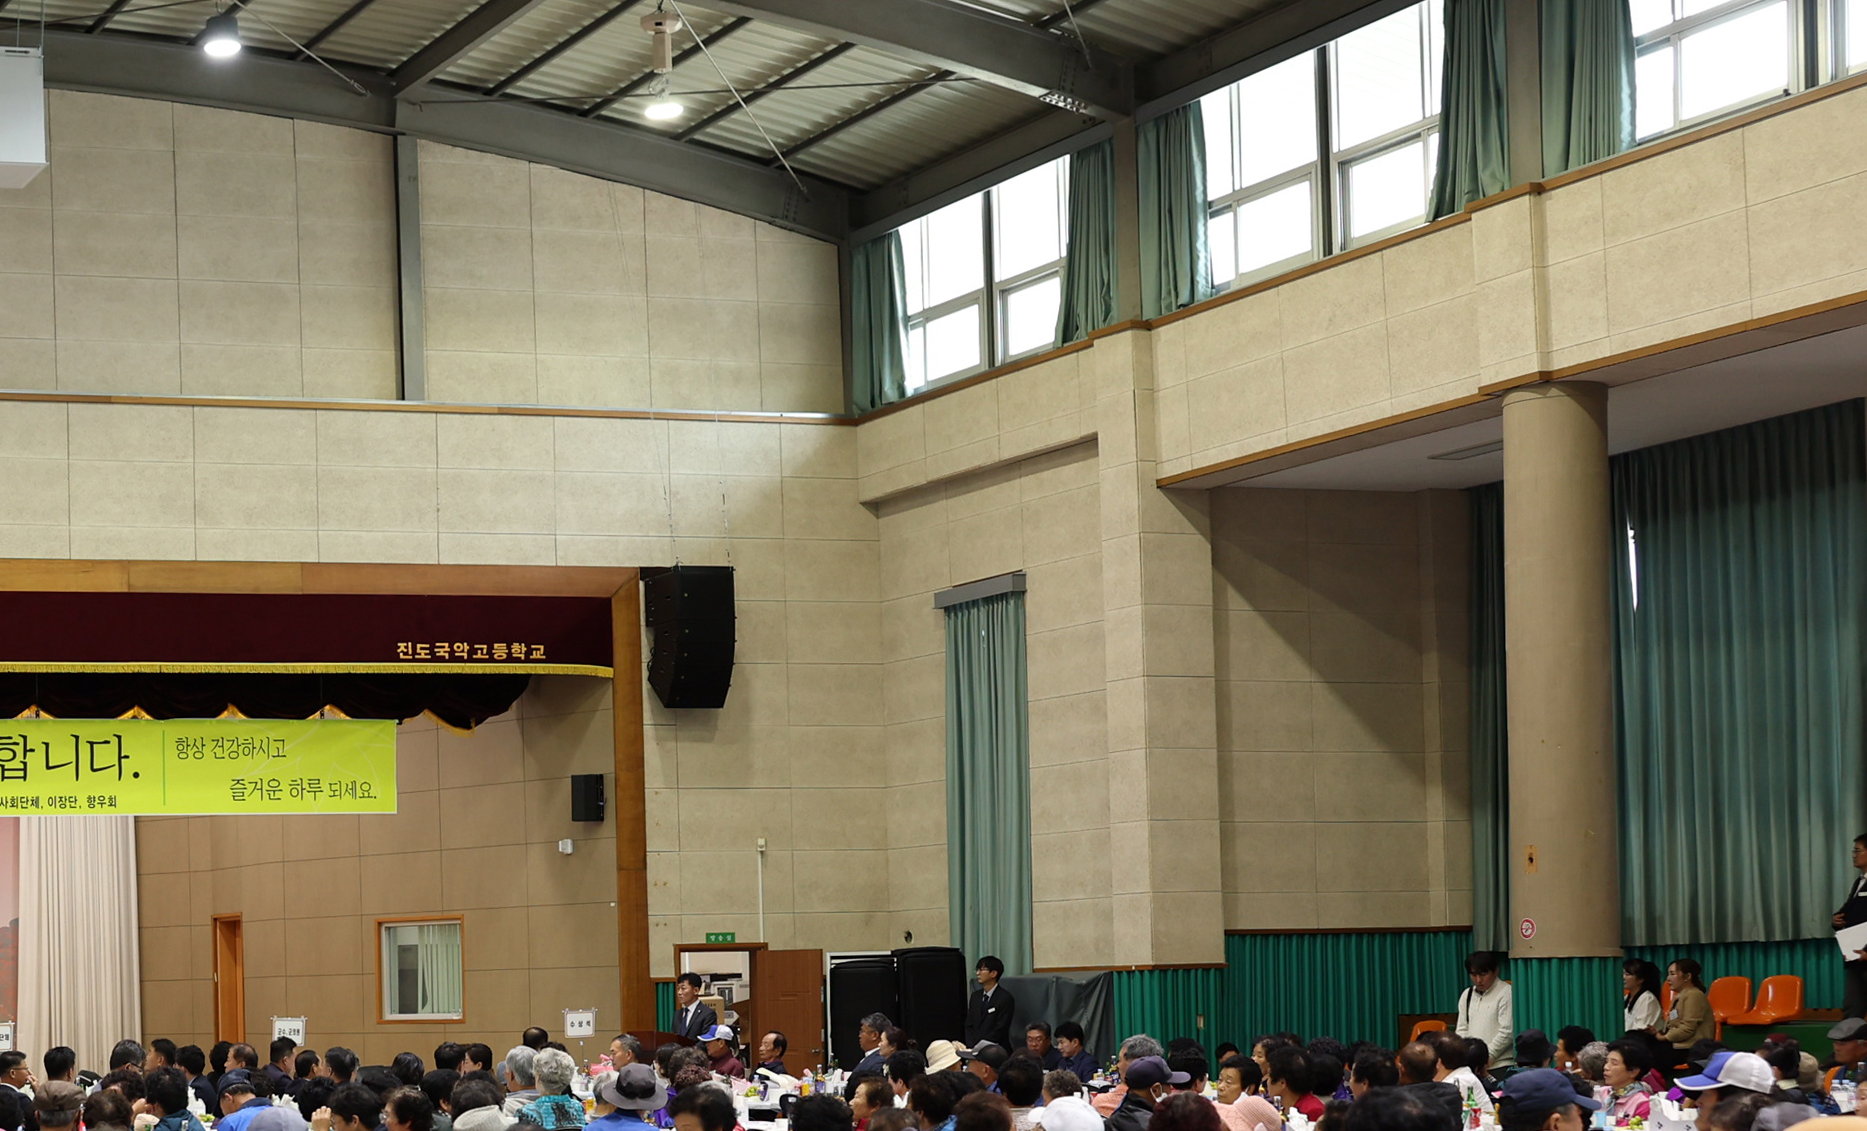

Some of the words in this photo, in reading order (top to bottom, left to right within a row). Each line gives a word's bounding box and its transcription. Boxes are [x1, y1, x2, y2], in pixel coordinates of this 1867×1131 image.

[396, 641, 547, 660] 진도국악고등학교
[175, 736, 206, 760] 항상
[210, 736, 287, 760] 건강하시고
[229, 777, 283, 801] 즐거운
[288, 777, 324, 801] 하루
[328, 779, 377, 800] 되세요.
[47, 796, 83, 809] 이장단,
[86, 794, 118, 809] 향우회
